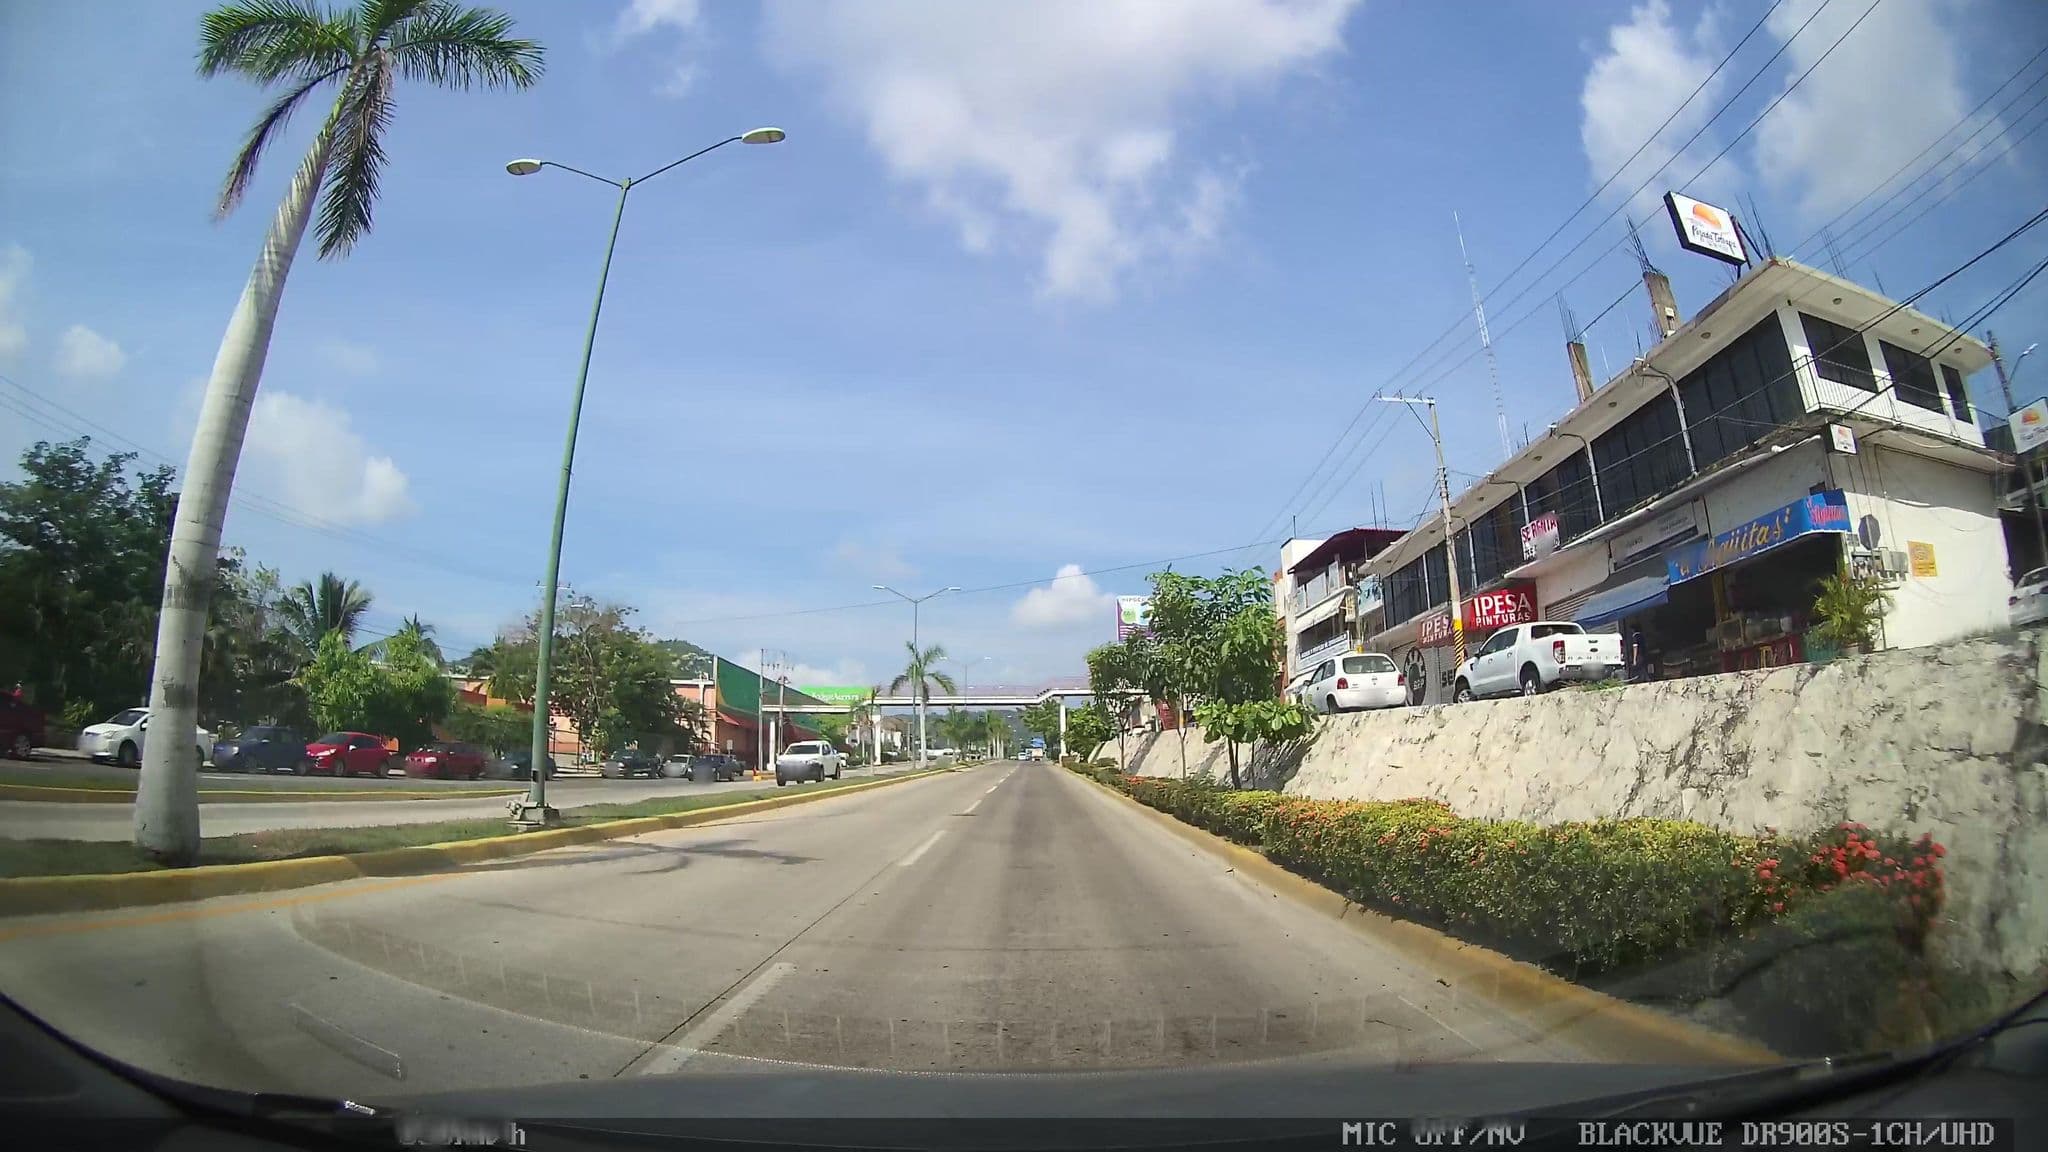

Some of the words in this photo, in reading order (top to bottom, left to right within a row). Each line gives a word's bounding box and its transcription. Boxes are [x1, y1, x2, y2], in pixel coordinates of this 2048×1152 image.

[1474, 593, 1532, 616] IPESA
[1476, 611, 1531, 627] PINTURAS
[1422, 629, 1453, 644] PINTURA
